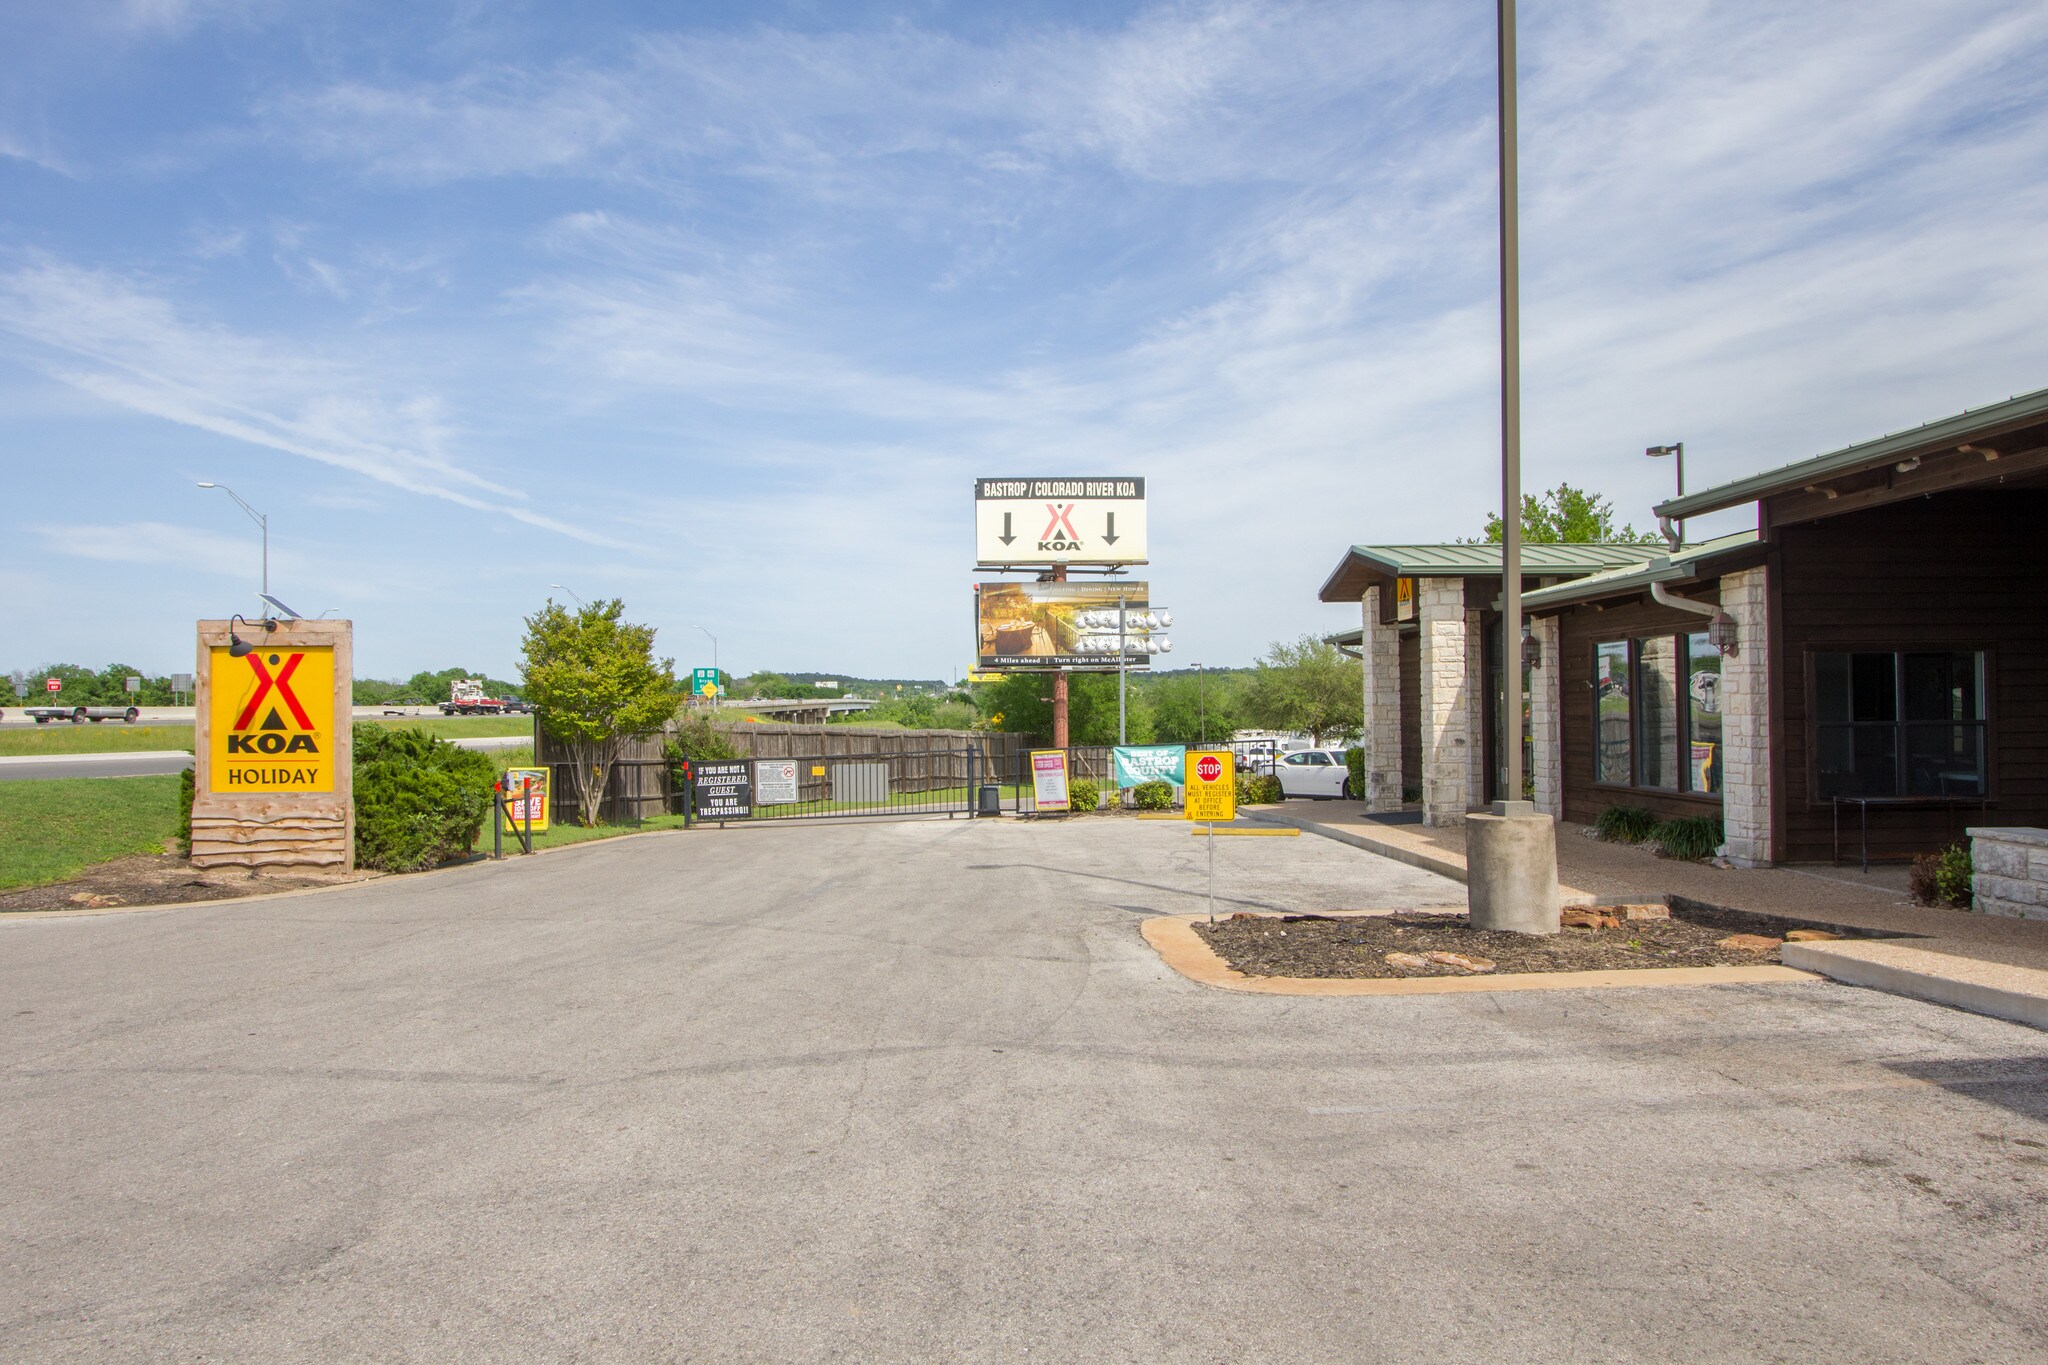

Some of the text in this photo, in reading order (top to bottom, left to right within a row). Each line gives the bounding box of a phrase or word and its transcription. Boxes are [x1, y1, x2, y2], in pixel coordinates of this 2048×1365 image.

[984, 482, 1026, 497] BASTROP
[1035, 482, 1084, 496] COLORADO
[1086, 482, 1114, 496] RIVER
[1116, 482, 1136, 496] KOA
[1038, 542, 1082, 551] KOA
[228, 733, 320, 754] KOA
[1121, 756, 1179, 766] BASTROP
[699, 765, 746, 775] IF YOU ARE NOT A
[1198, 764, 1221, 775] STOP
[229, 769, 318, 784] HOLIDAY
[698, 775, 748, 784] REGISTERED
[710, 786, 736, 794] GUEST
[710, 798, 738, 806] YOU ARE
[700, 806, 749, 816] TRESPASSING!!
